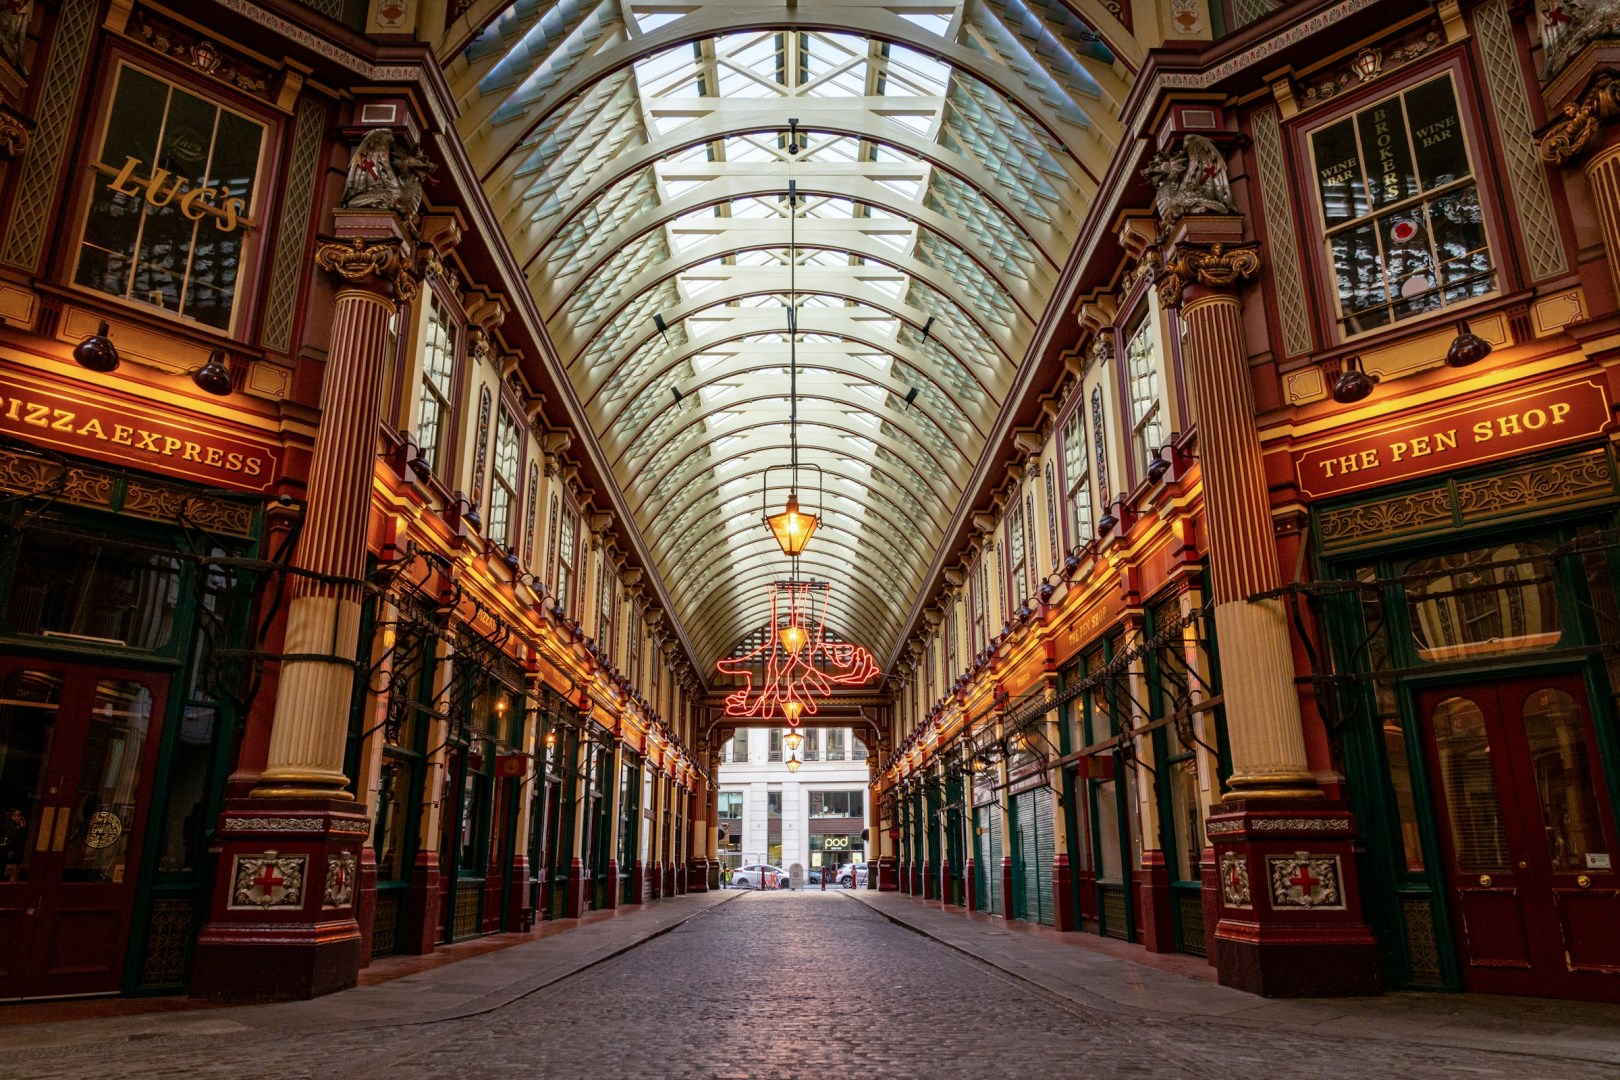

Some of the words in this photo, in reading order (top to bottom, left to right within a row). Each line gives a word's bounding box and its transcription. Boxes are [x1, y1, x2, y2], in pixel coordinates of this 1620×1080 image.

[1416, 116, 1456, 139] WINE
[1423, 130, 1452, 148] BAR
[1373, 109, 1400, 198] BROKERS
[1320, 157, 1357, 178] WINE
[1327, 170, 1354, 187] BAR
[107, 155, 245, 232] LUC'S
[0, 396, 262, 476] IZZAEXPRESS
[1319, 449, 1380, 478] THE
[1390, 429, 1458, 462] PEN
[1472, 402, 1571, 443] SHOP
[825, 835, 848, 849] pod
